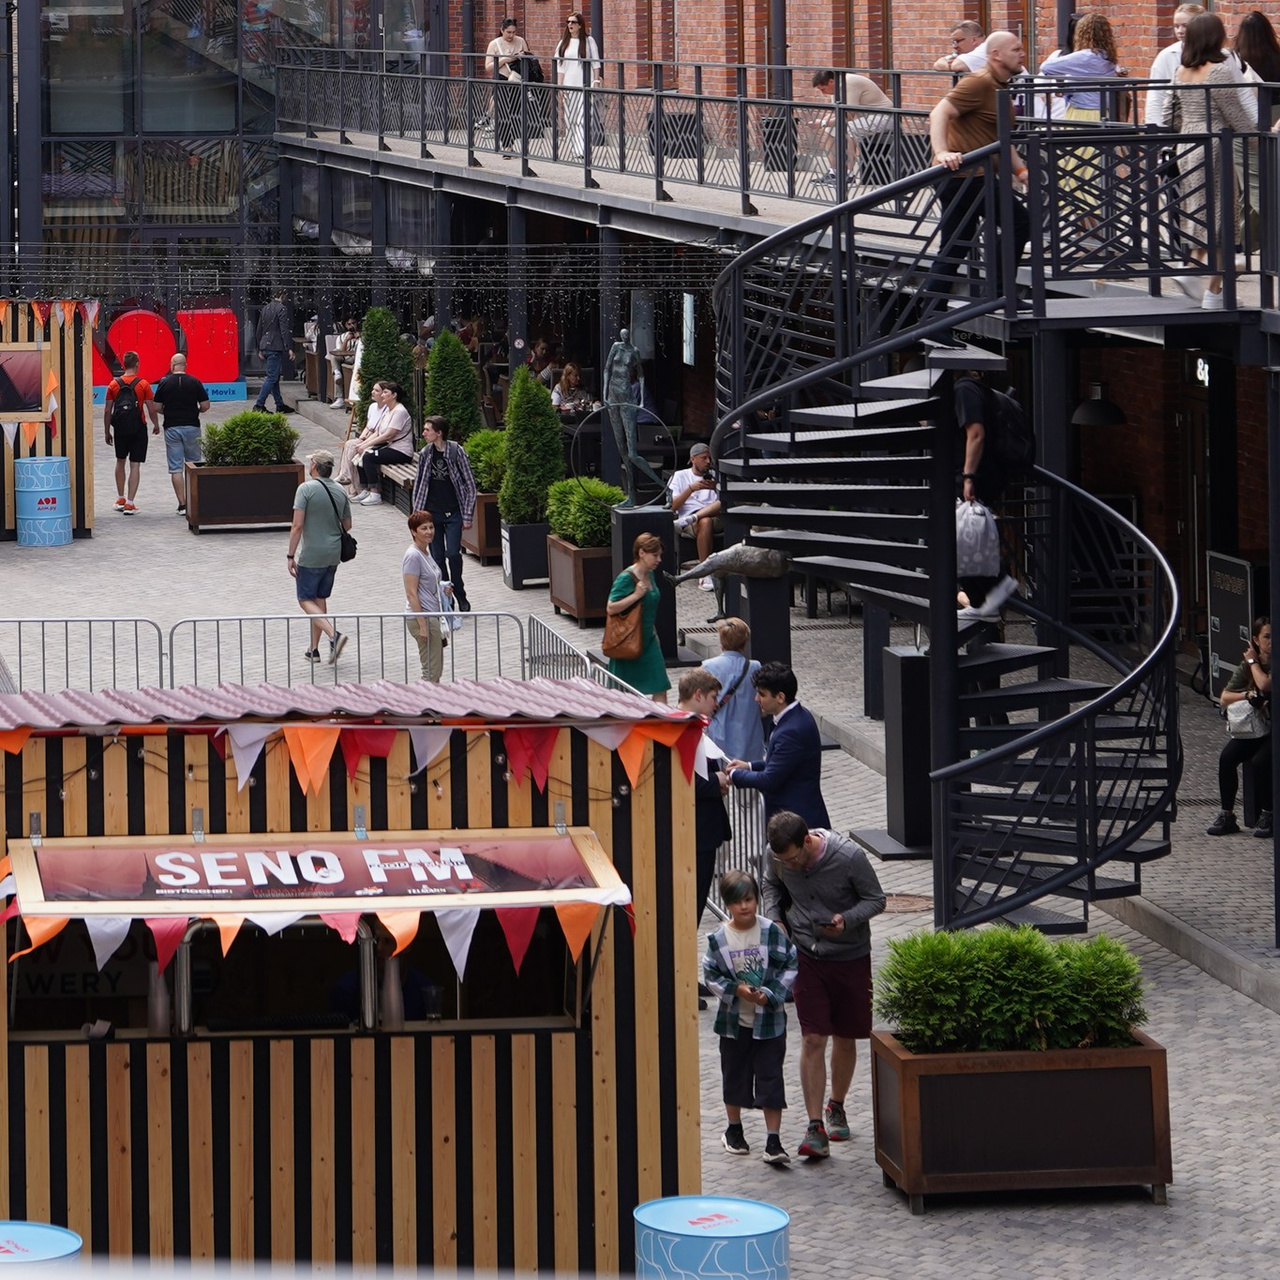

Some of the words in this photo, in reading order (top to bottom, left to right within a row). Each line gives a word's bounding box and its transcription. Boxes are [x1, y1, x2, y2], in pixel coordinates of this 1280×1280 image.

[155, 849, 345, 887] SENO
[362, 847, 474, 883] FM
[12, 970, 123, 995] WERY
